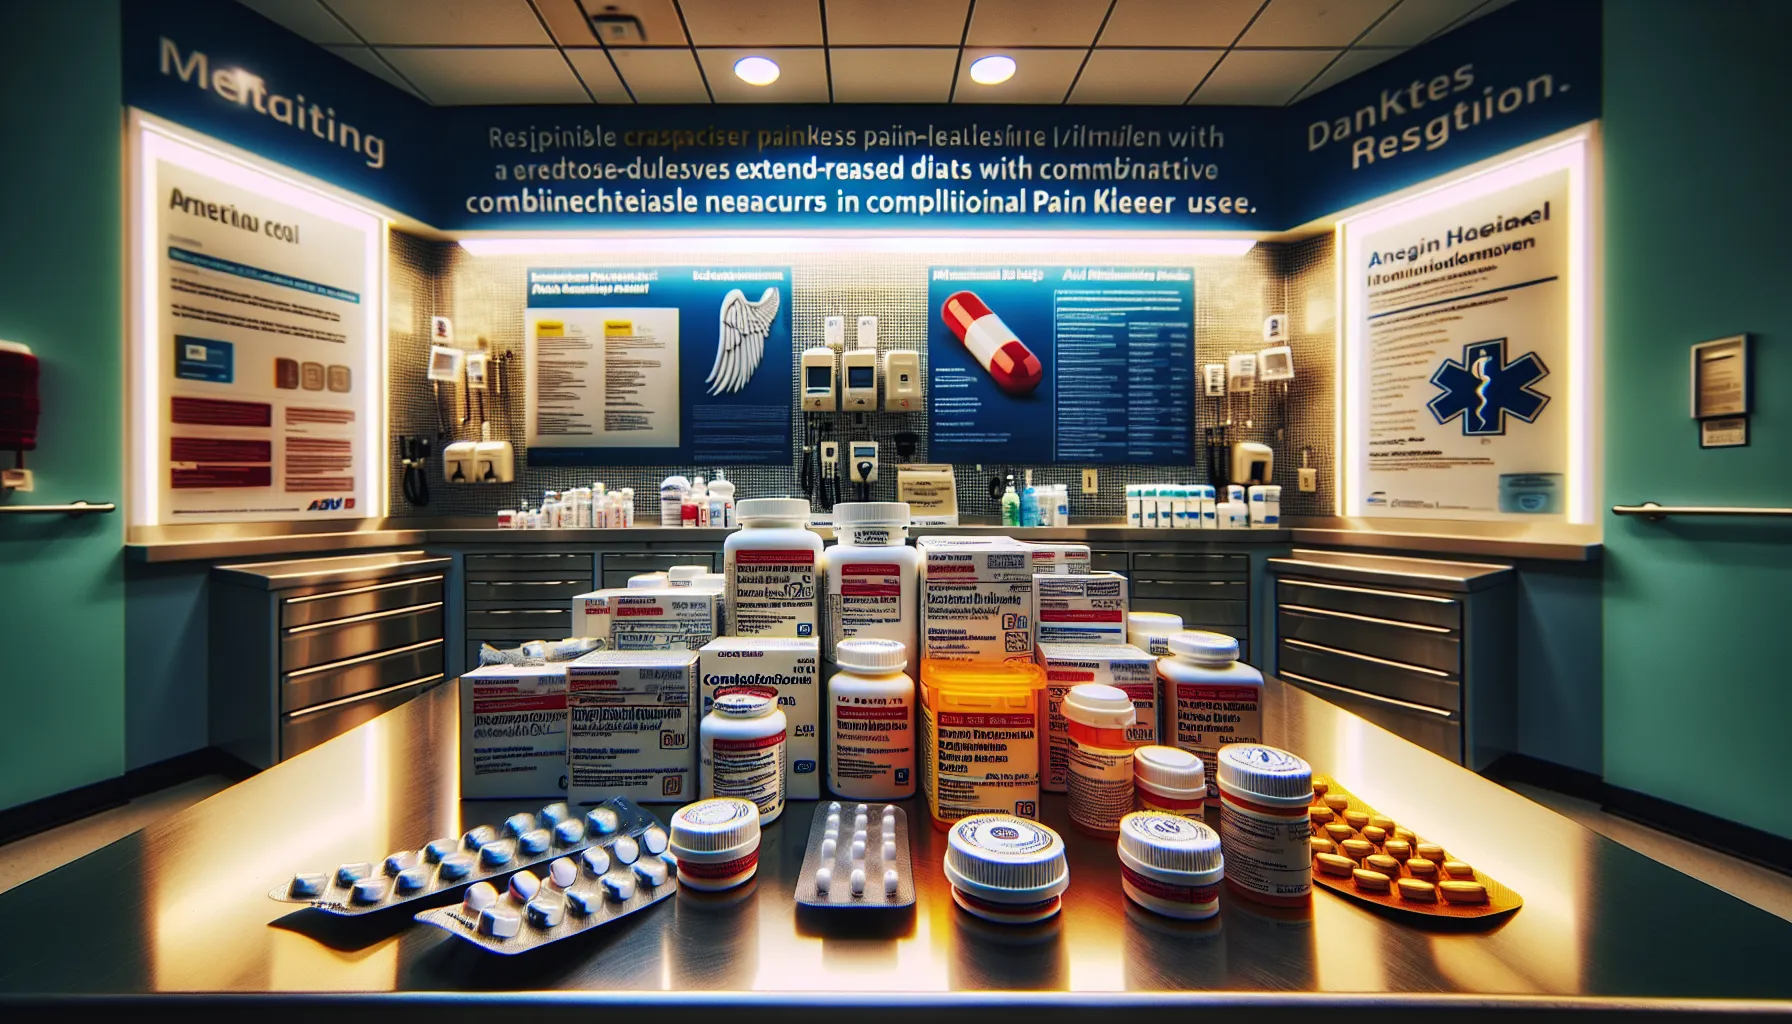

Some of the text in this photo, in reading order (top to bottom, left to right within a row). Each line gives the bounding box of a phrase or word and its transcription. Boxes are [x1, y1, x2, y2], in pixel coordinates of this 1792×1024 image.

[1168, 125, 1225, 149] with
[979, 155, 1033, 181] with
[836, 188, 860, 213] in
[1033, 189, 1087, 214] Pain
